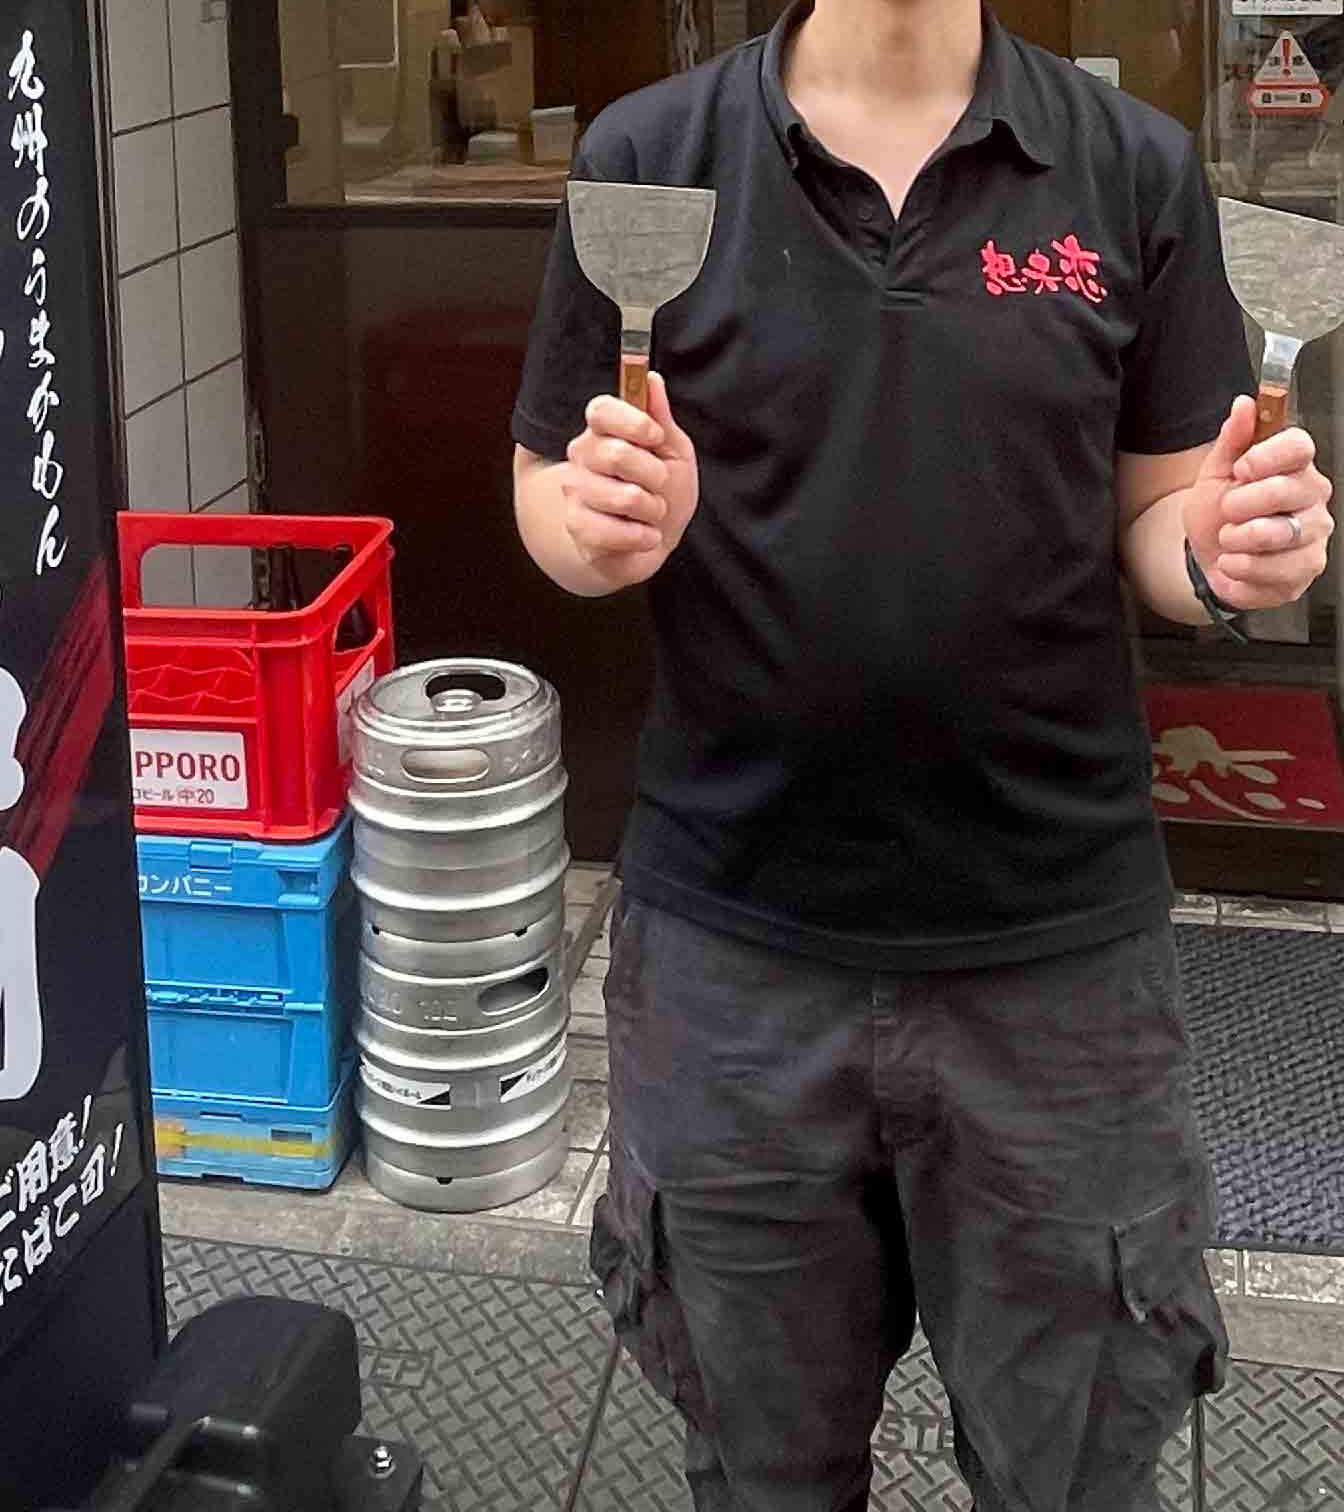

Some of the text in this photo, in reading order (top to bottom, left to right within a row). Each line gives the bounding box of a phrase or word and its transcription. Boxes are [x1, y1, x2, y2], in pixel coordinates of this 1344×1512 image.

[7, 29, 69, 576] 九州のうまかもん
